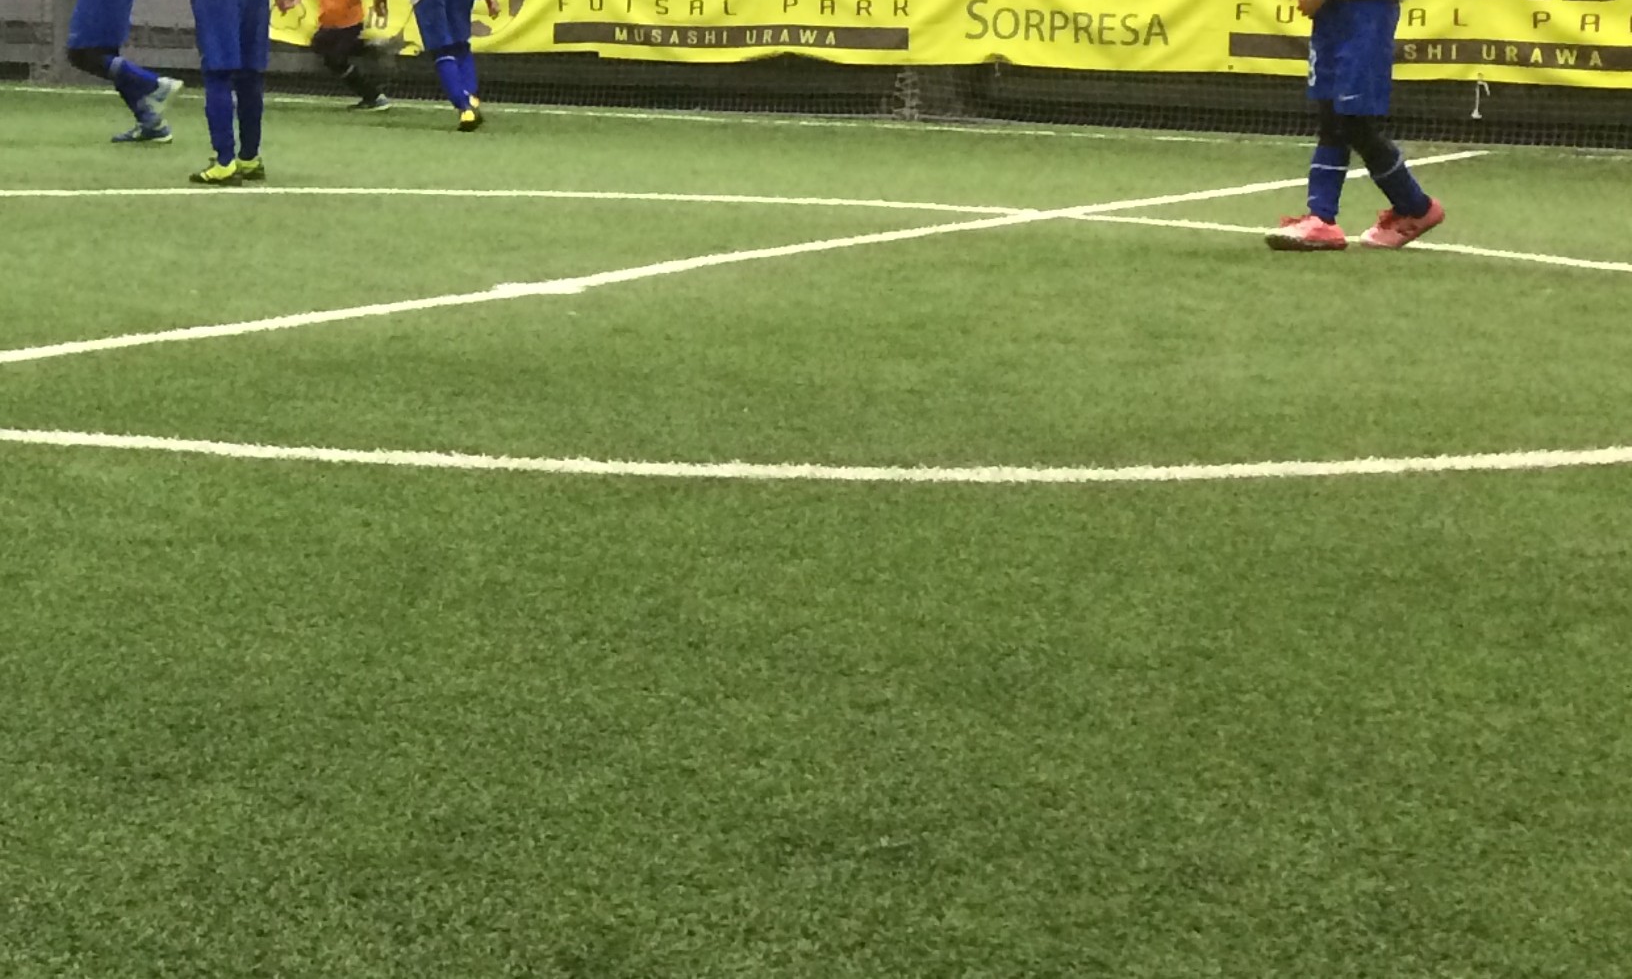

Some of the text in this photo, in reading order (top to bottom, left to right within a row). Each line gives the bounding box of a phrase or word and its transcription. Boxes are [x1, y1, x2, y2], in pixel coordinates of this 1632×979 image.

[1531, 11, 1632, 33] PA
[614, 27, 836, 45] MUSASHI URAWA
[1482, 43, 1603, 67] URAWA
